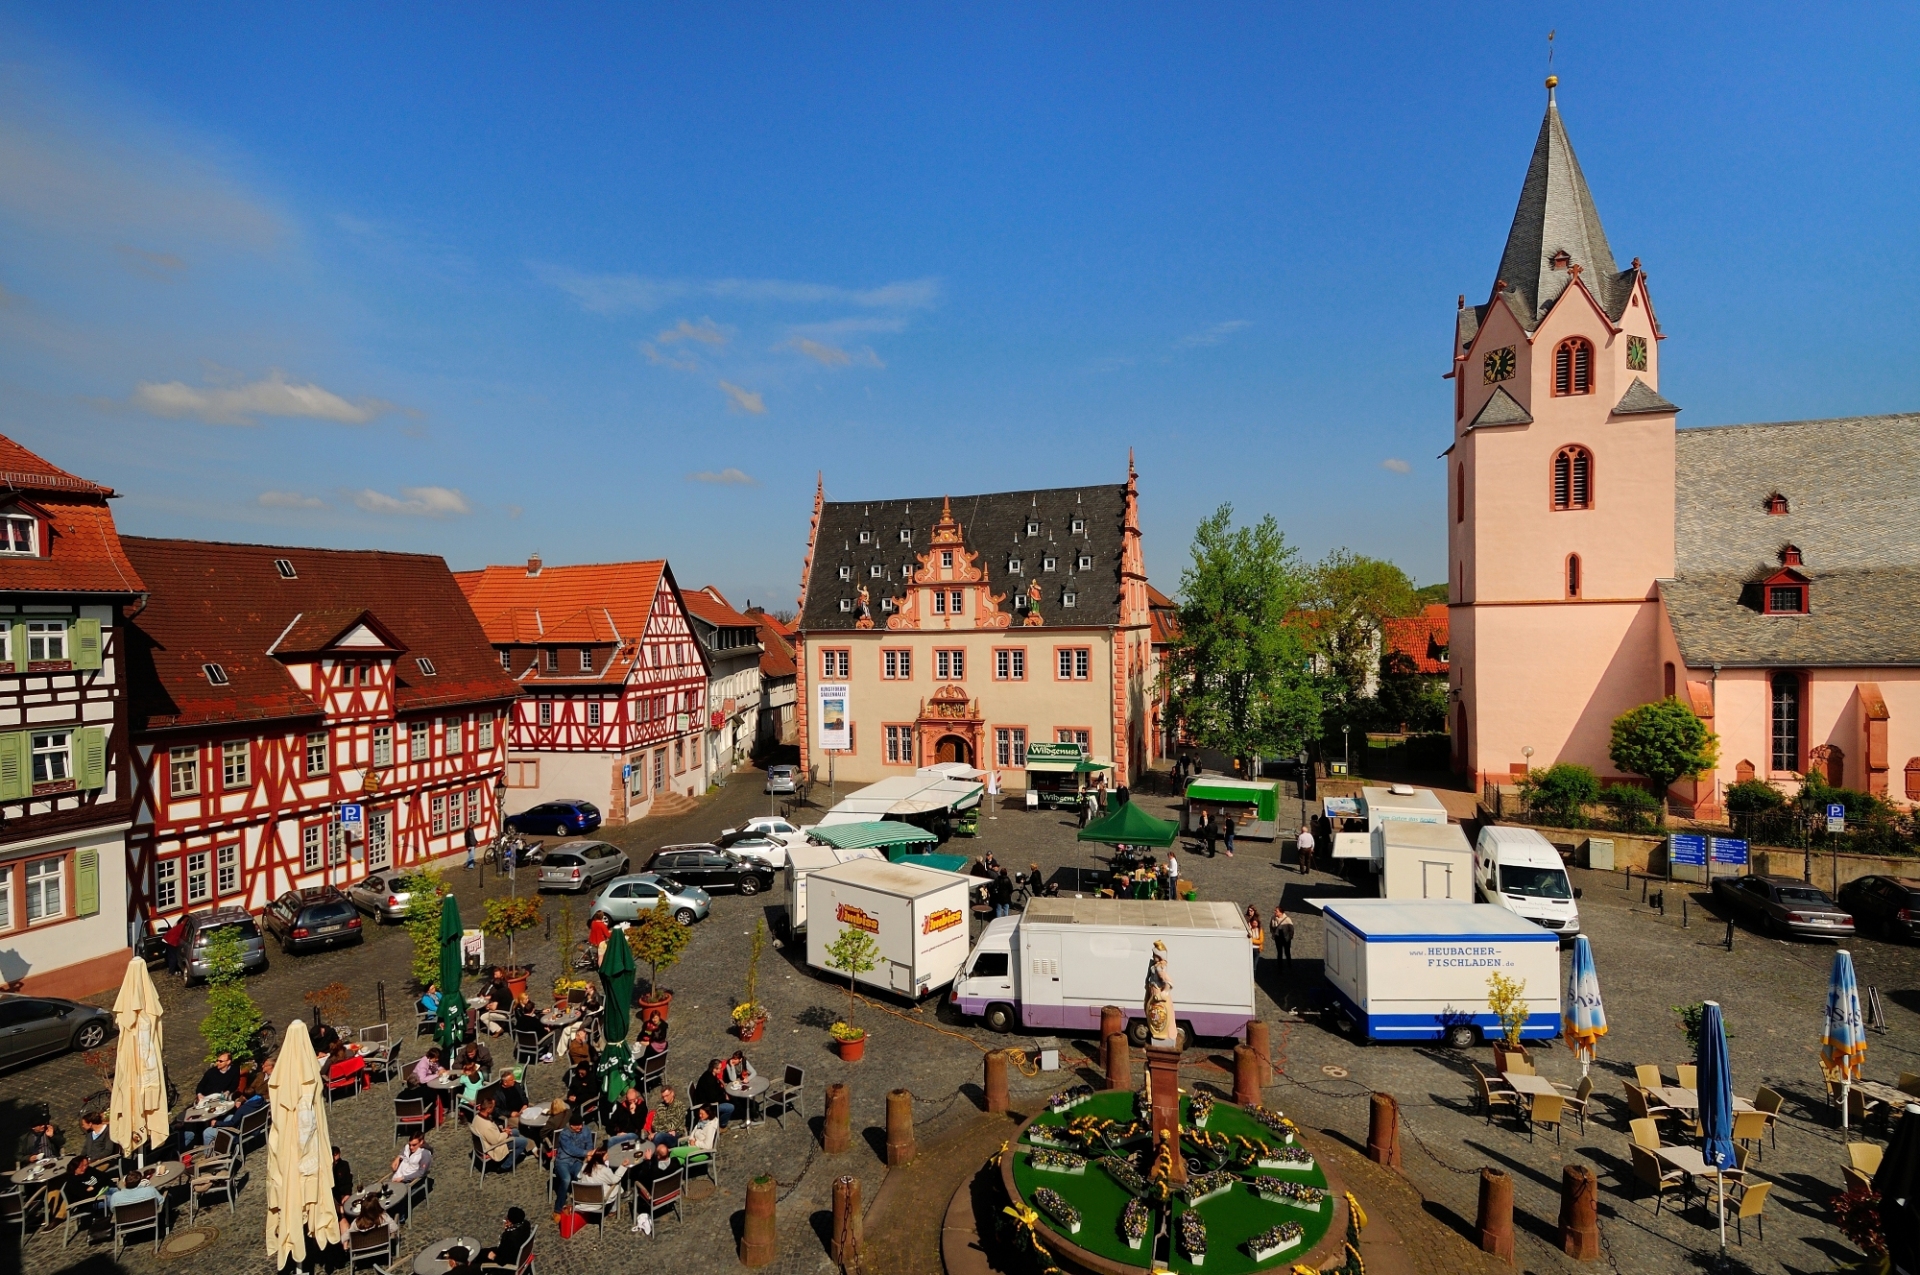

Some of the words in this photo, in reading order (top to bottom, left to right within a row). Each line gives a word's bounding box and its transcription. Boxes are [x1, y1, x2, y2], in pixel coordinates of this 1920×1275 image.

[1031, 746, 1078, 757] Wildgenuss
[345, 806, 357, 821] P
[1831, 806, 1841, 817] P
[1409, 947, 1502, 956] www.HEUBACHER-
[1427, 958, 1515, 967] FISCHLADEN.de
